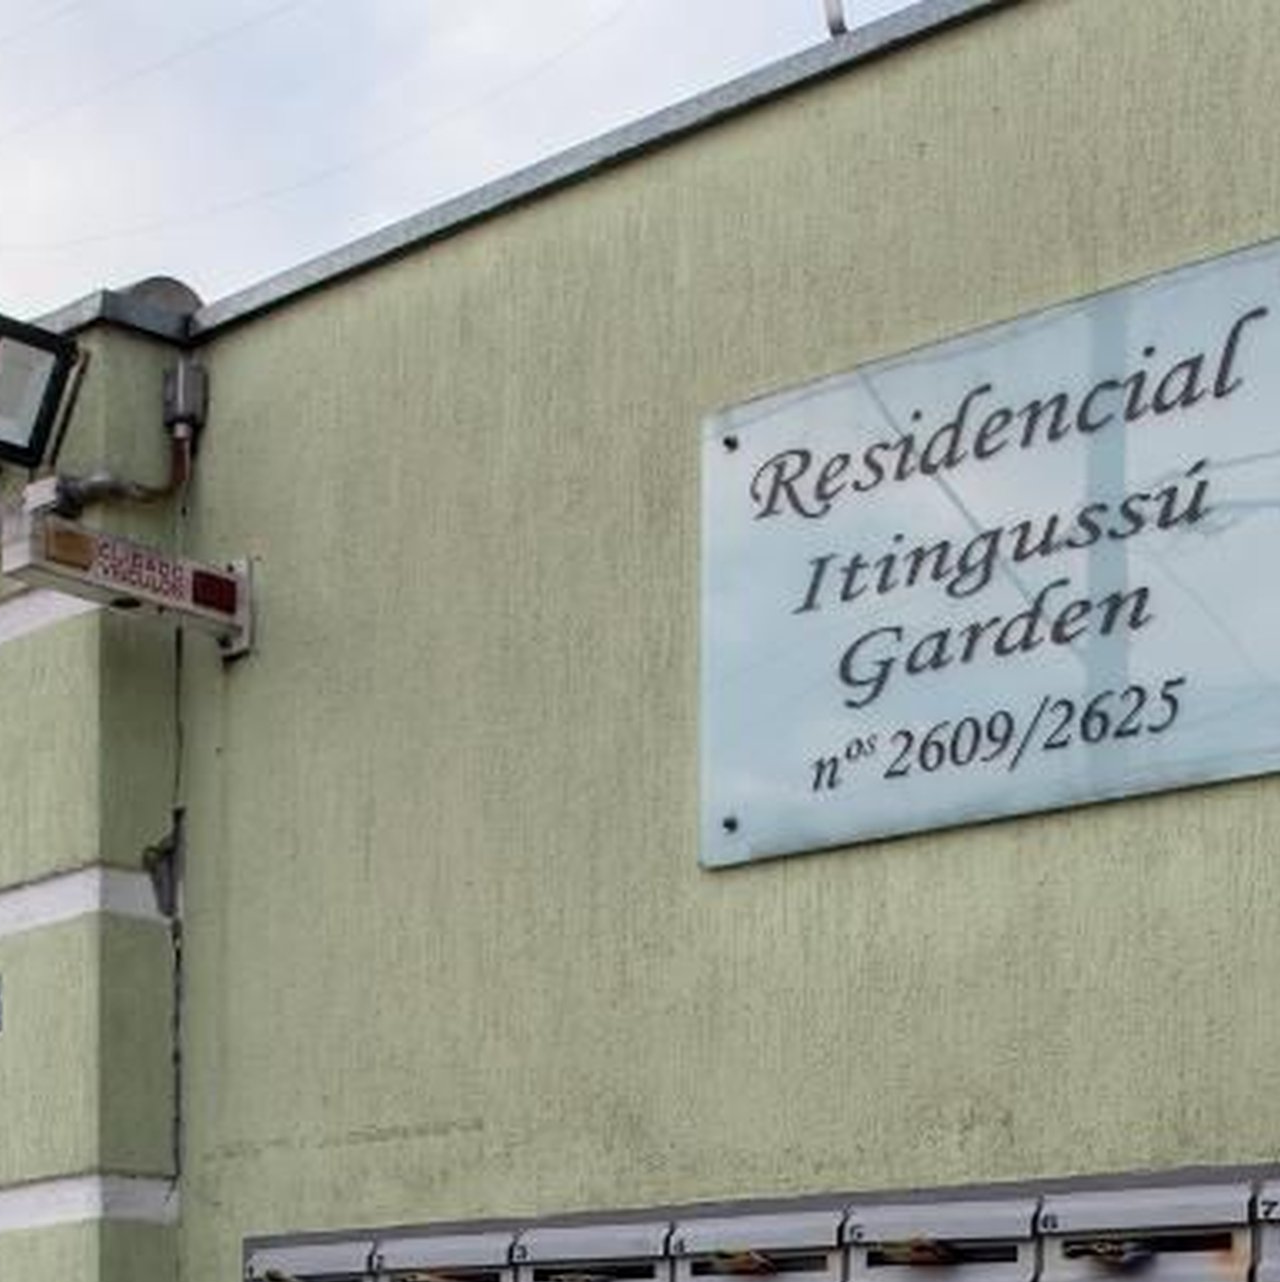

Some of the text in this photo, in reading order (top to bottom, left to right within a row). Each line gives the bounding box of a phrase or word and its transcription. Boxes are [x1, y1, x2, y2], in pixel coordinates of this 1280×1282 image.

[749, 307, 1270, 522] Residencial
[794, 458, 1214, 615] Itingussú
[838, 578, 1155, 710] Garden
[883, 677, 1187, 780] 2609/2625
[516, 1244, 528, 1261] 3
[1261, 1199, 1279, 1219] 7
